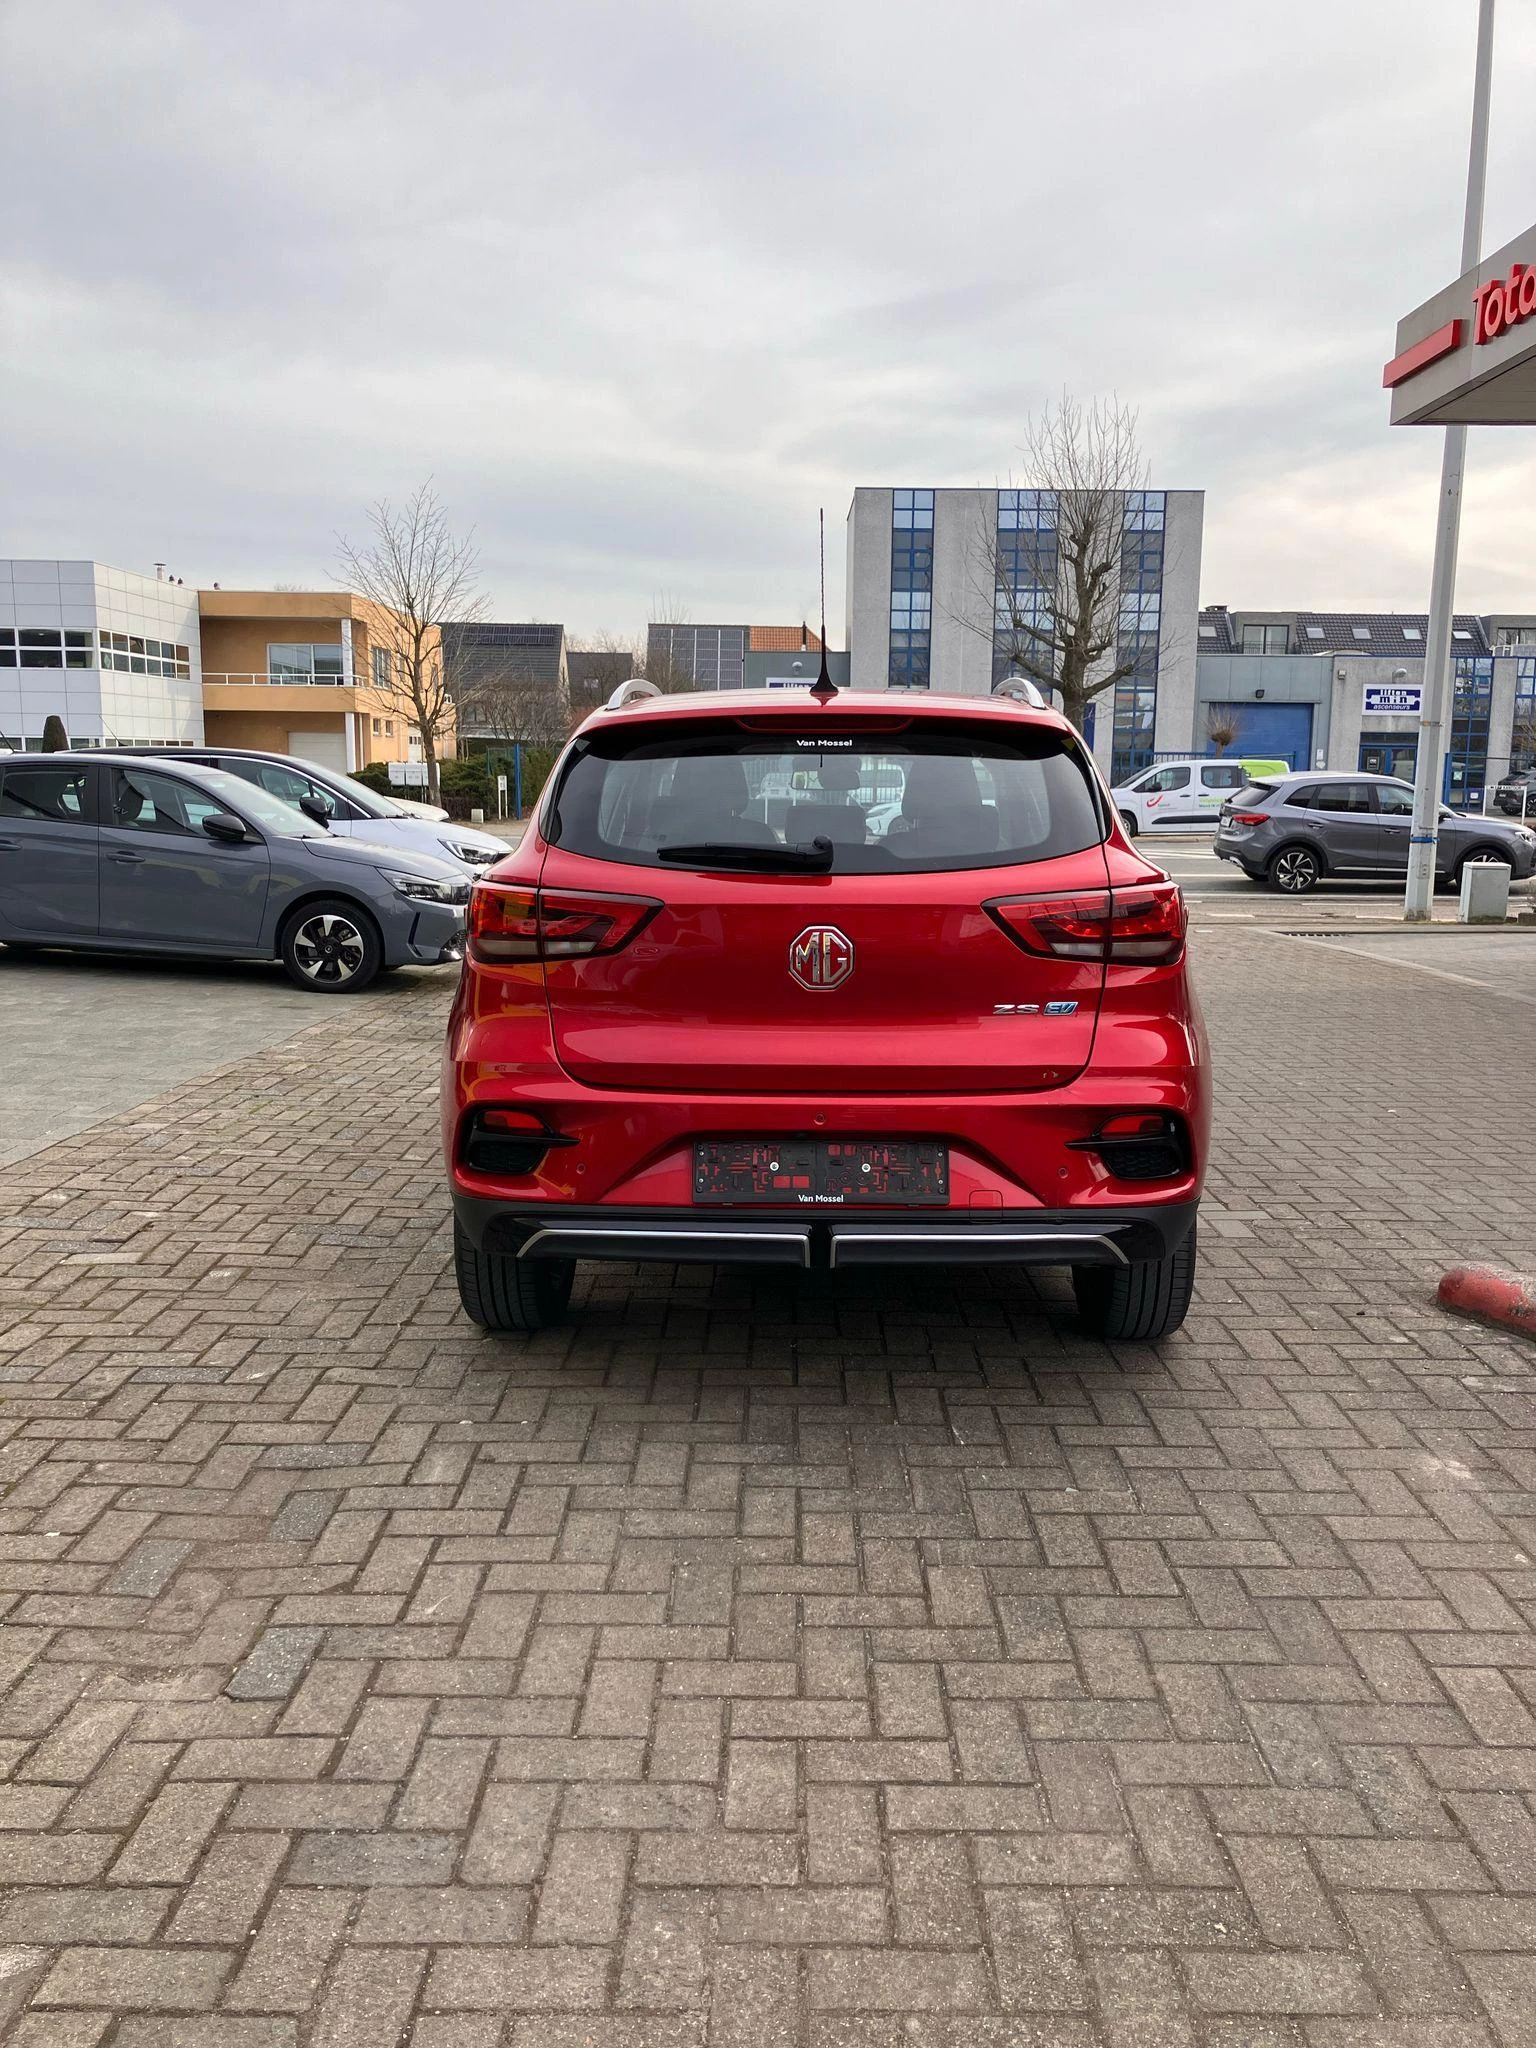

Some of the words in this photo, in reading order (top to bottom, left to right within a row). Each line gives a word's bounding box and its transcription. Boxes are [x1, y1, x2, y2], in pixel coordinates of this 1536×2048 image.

[1379, 695, 1408, 704] min
[817, 739, 853, 747] Mossel
[795, 931, 848, 984] MG
[992, 1004, 1040, 1015] ZS
[1045, 1002, 1077, 1014] EV
[798, 1194, 814, 1203] Van
[815, 1194, 844, 1203] Mossel
